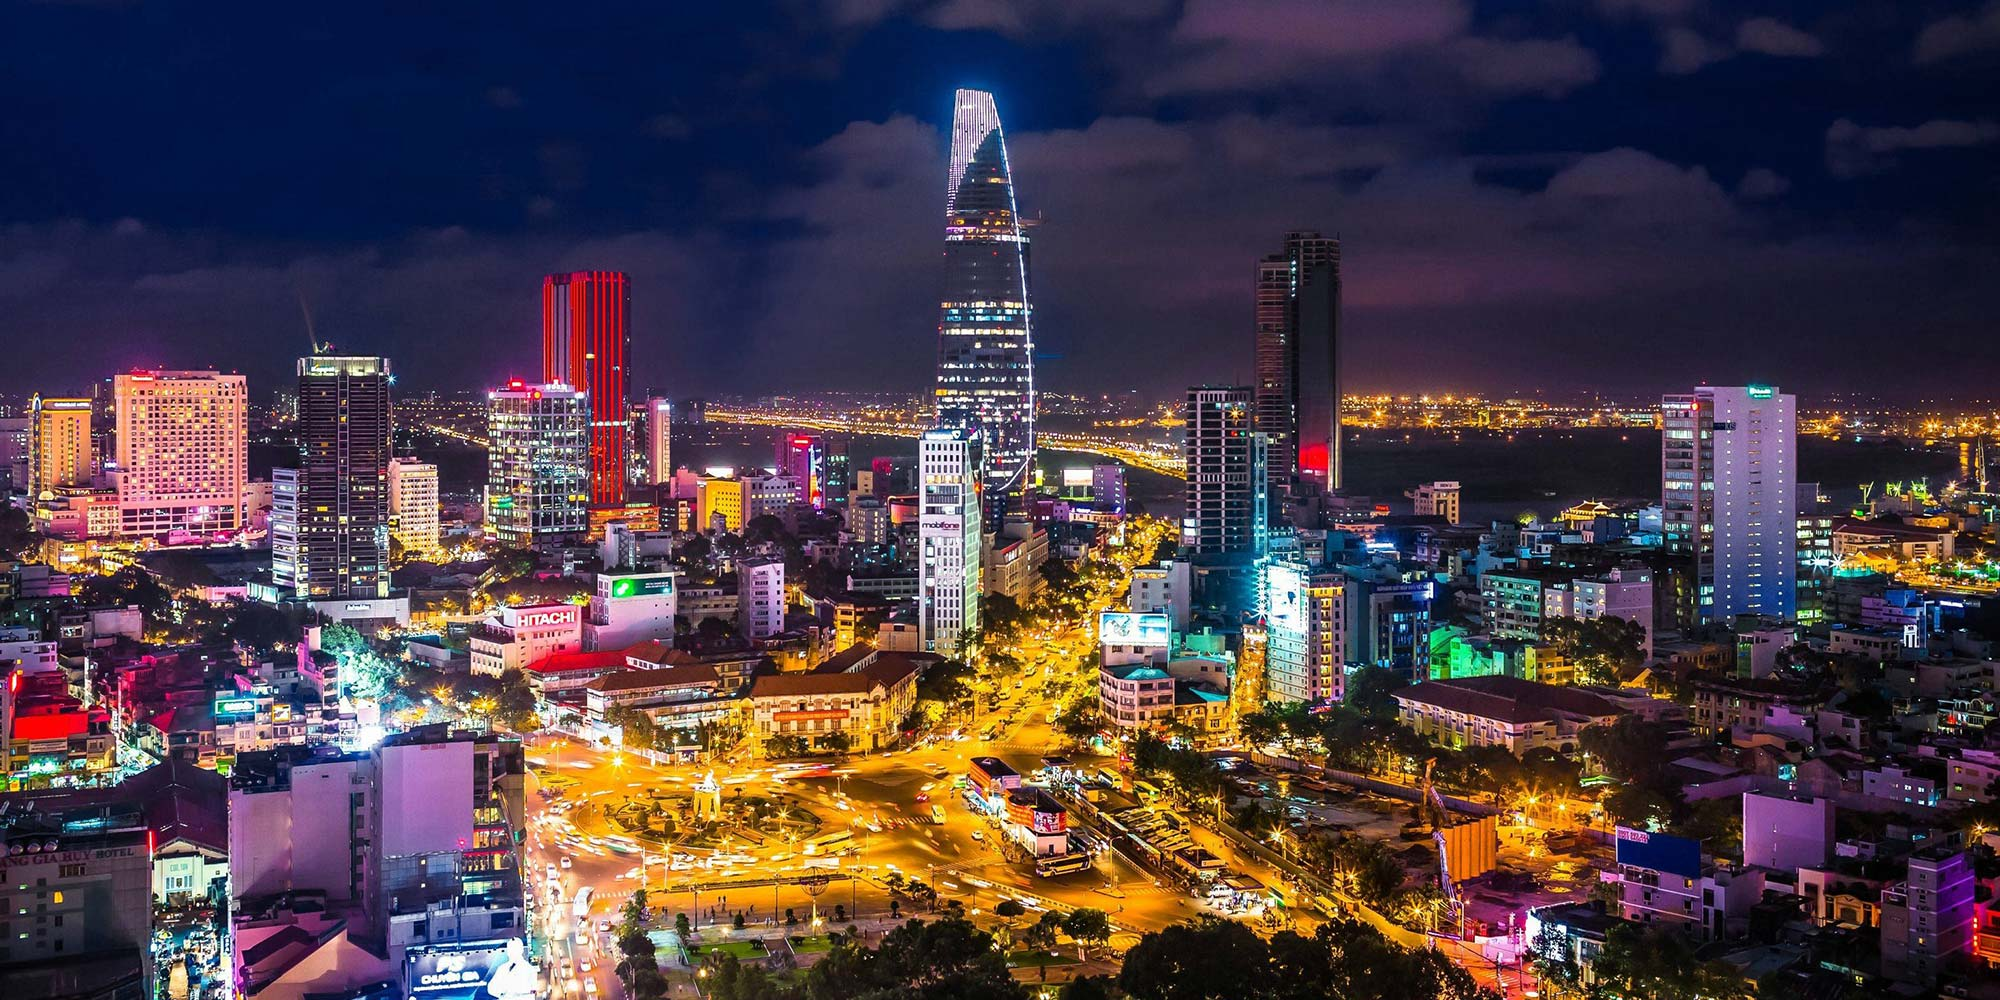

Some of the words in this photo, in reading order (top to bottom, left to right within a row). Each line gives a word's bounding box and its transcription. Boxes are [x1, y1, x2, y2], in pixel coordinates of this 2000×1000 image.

[518, 611, 575, 627] HITACHI
[33, 854, 58, 865] GIA
[62, 851, 91, 861] HUY
[96, 848, 134, 858] HOTEL
